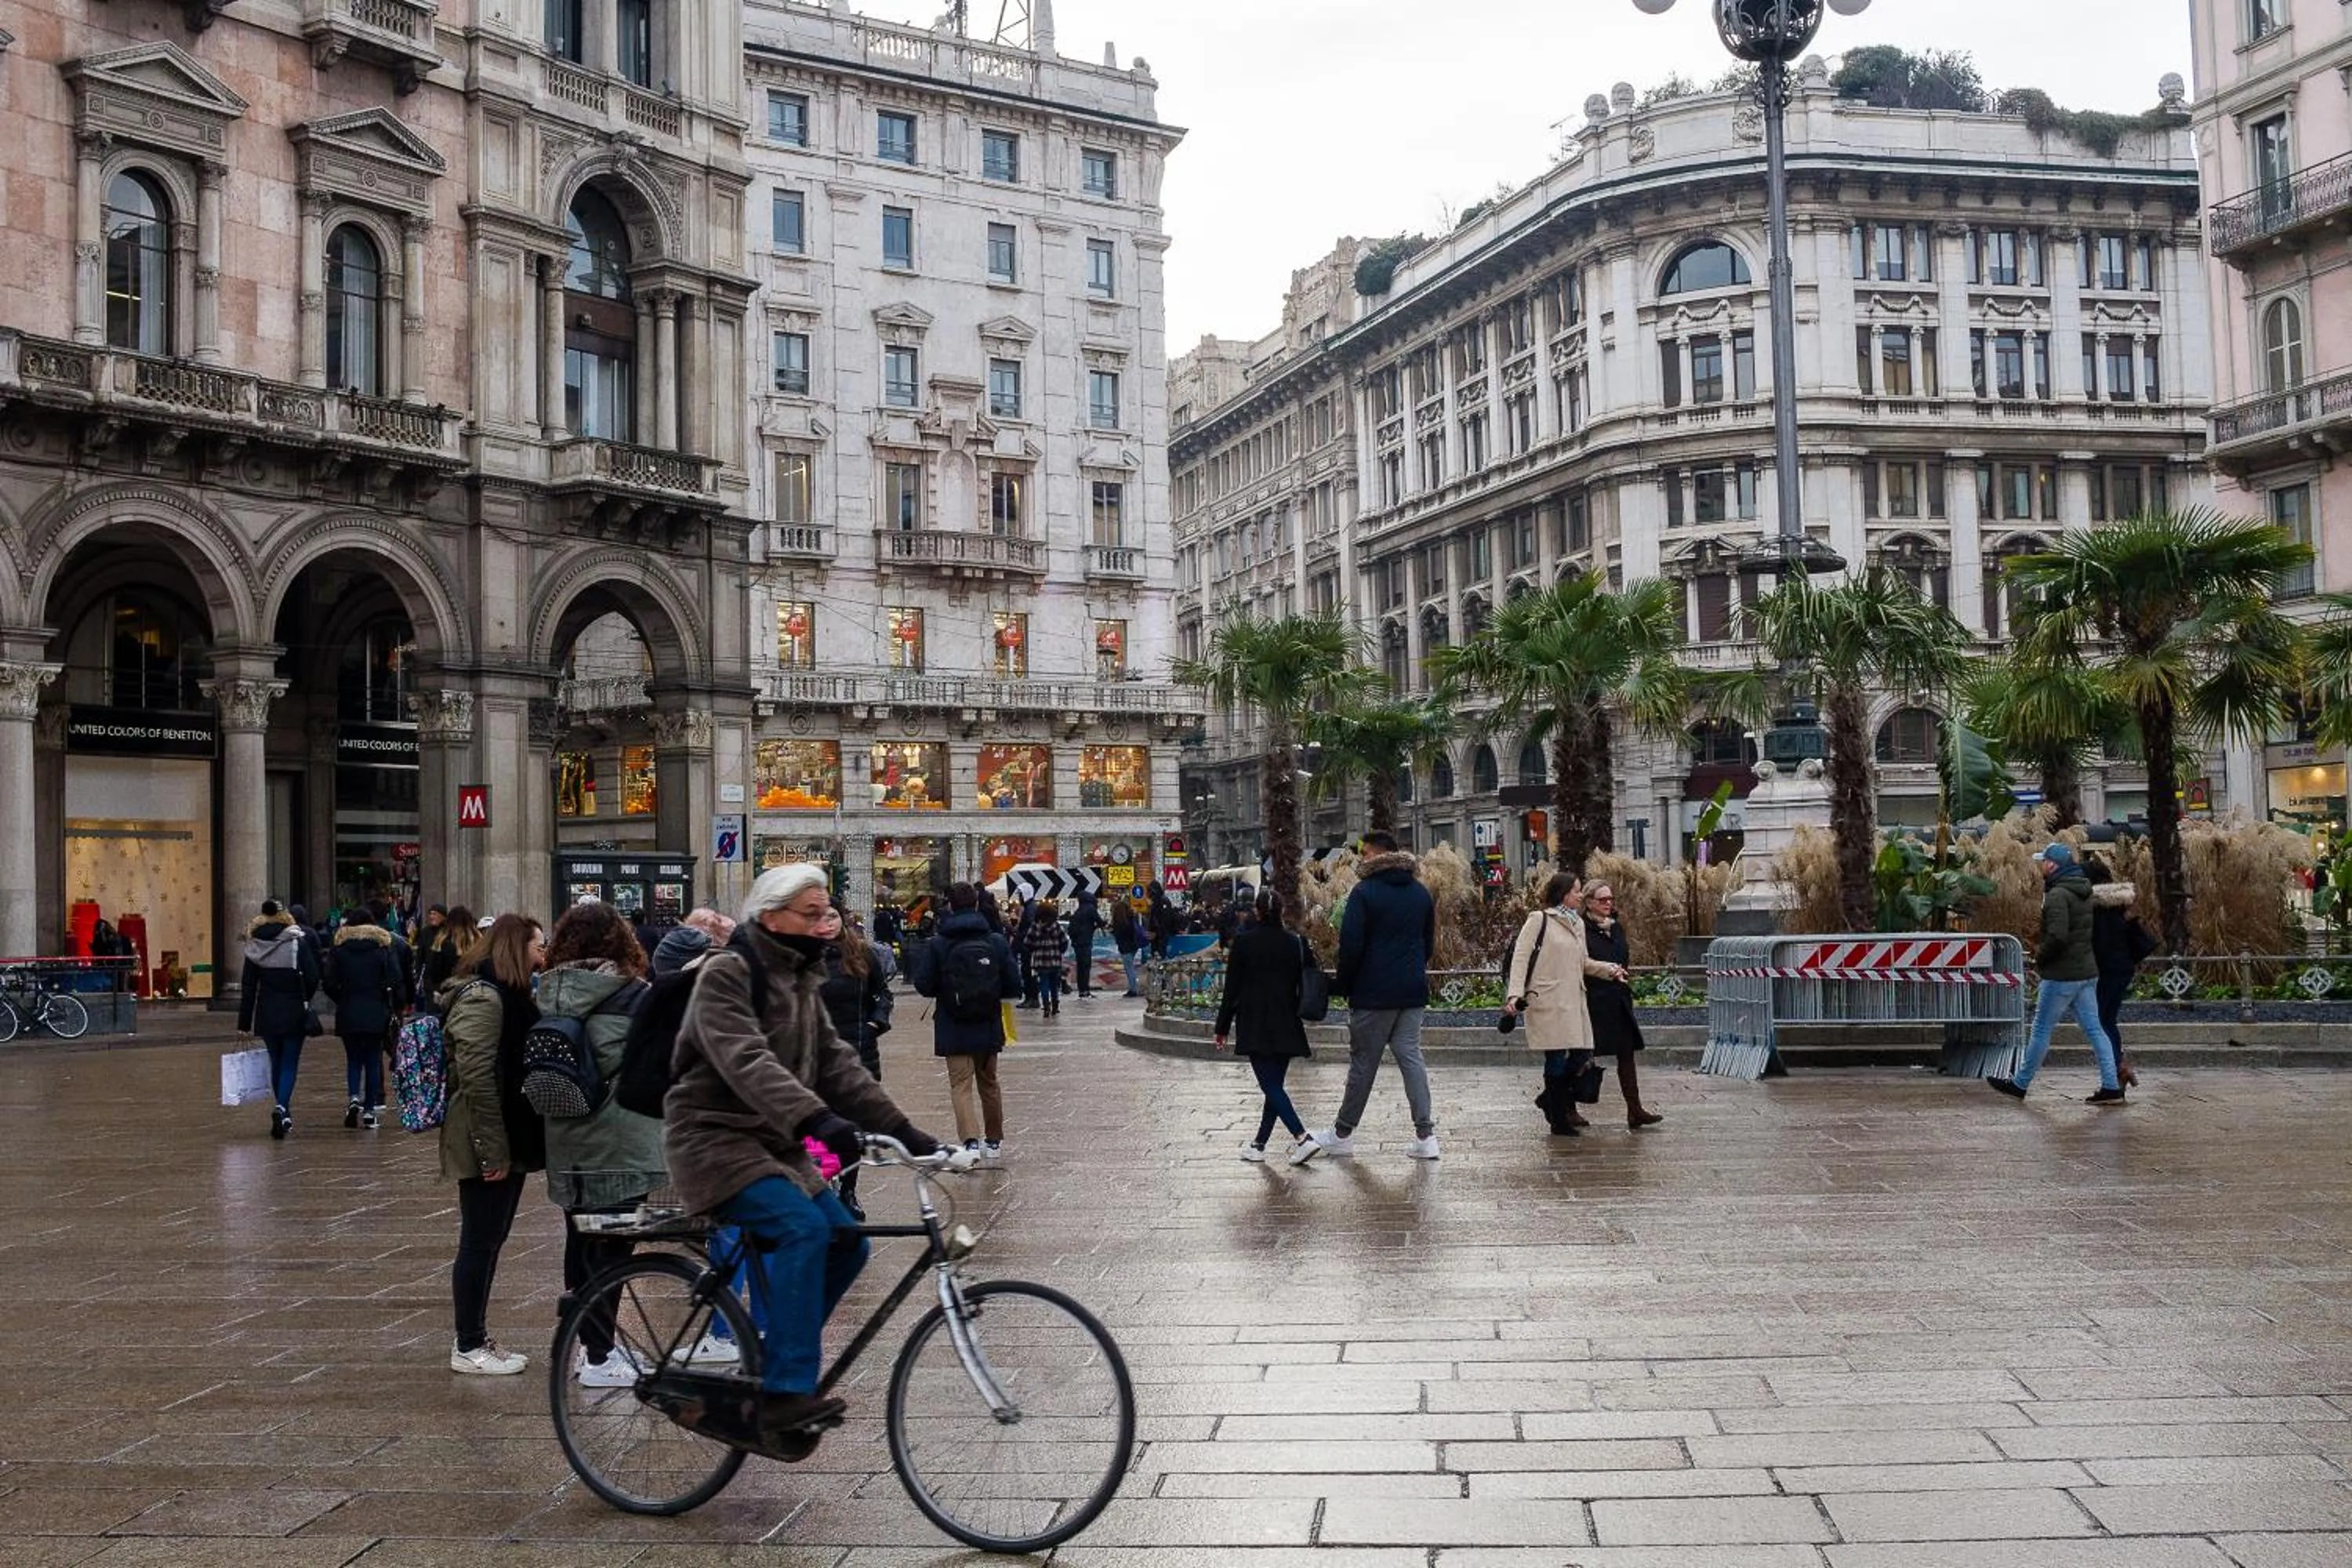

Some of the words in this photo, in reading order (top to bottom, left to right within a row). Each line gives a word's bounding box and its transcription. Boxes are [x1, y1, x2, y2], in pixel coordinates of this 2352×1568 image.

[68, 724, 106, 735] UNITED
[107, 726, 147, 738] COLORS
[147, 728, 162, 738] OF
[338, 739, 368, 749] UNITED
[369, 739, 402, 752] COLORS
[402, 742, 414, 752] OF
[462, 795, 485, 819] M
[1167, 869, 1186, 885] M
